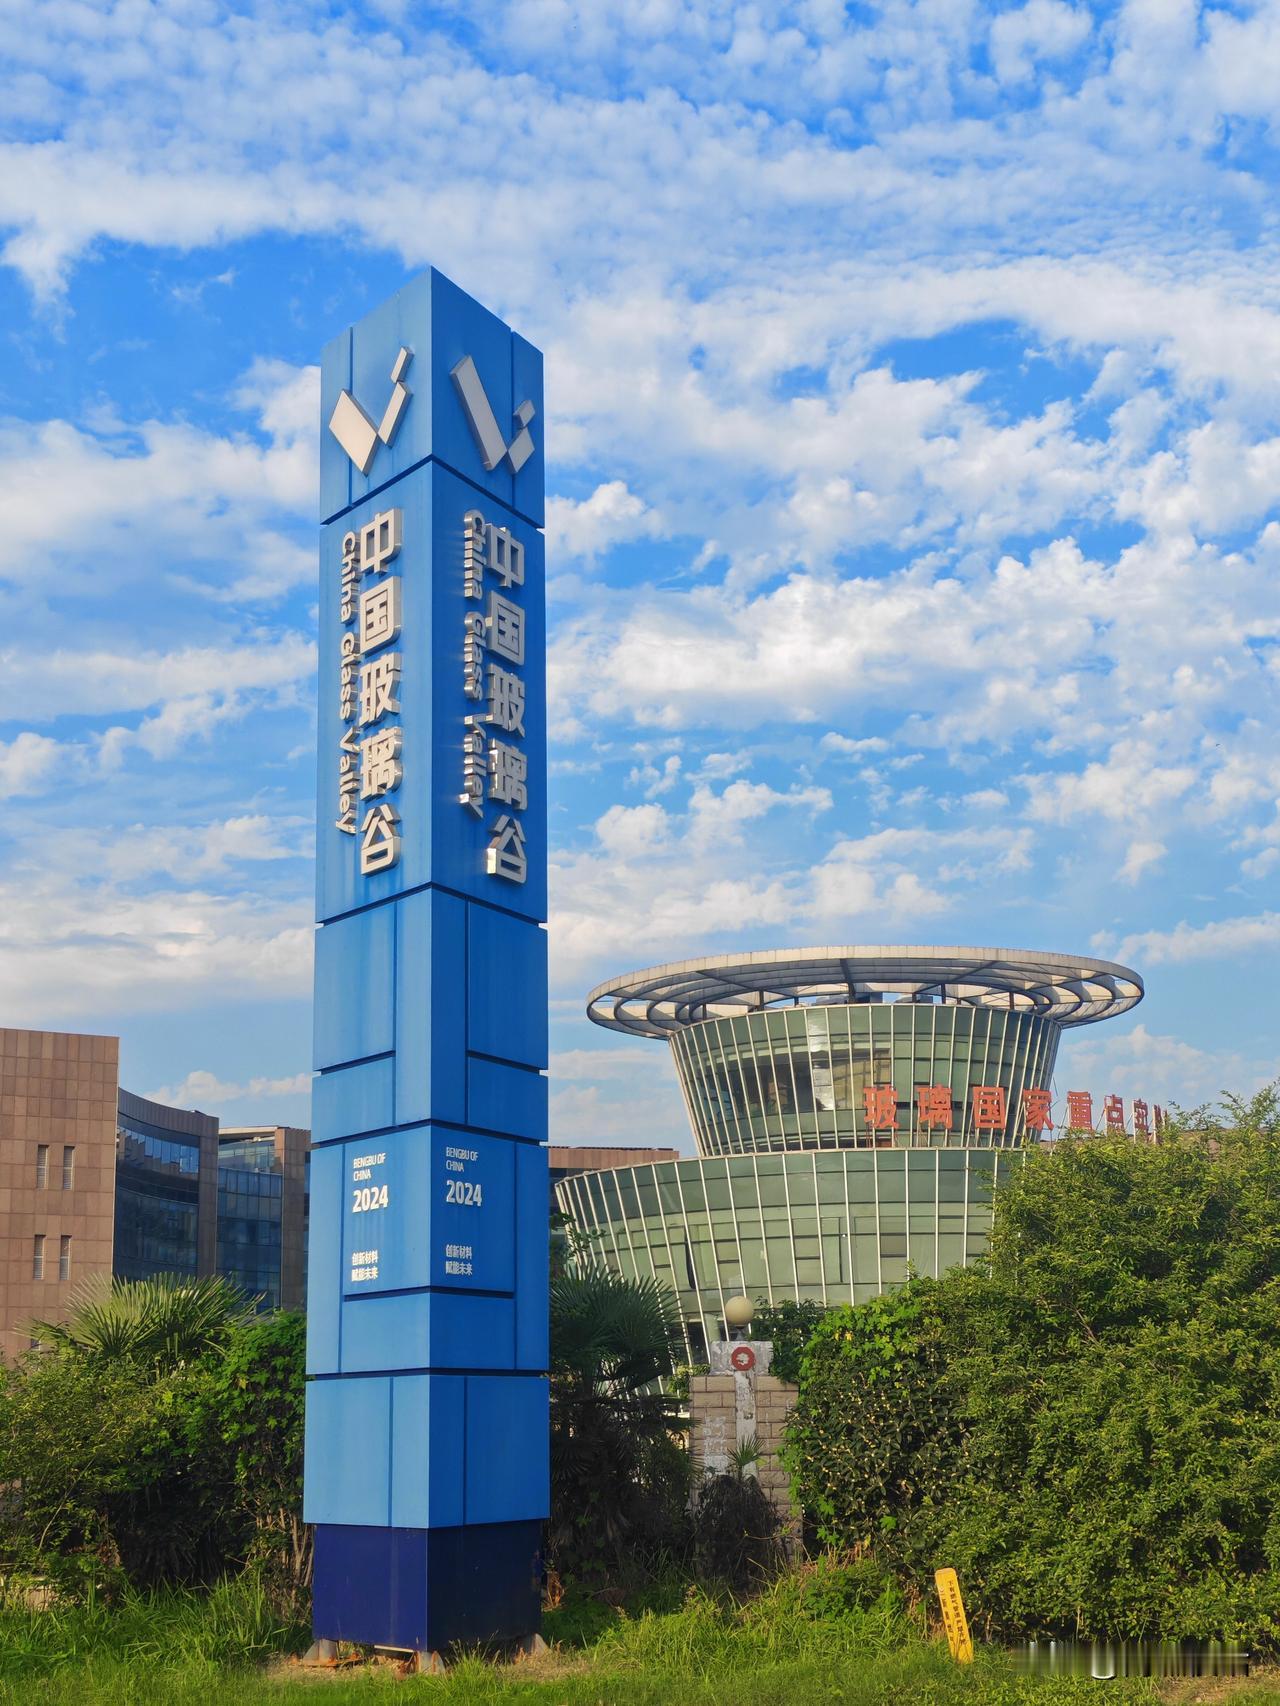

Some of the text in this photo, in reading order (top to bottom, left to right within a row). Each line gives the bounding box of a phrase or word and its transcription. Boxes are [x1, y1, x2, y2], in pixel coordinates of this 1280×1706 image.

[460, 510, 488, 818] China Glass Valley
[336, 532, 360, 834] China Glass Valley
[361, 509, 402, 876] 中国玻璃谷
[487, 524, 527, 883] 中国玻璃谷
[354, 1153, 386, 1168] BENGBU OF
[446, 1148, 479, 1161] BENGBU OF
[354, 1169, 371, 1181] CHINA
[446, 1161, 464, 1172] CHINA
[353, 1186, 388, 1212] 2024
[447, 1181, 482, 1206] 2024
[352, 1251, 378, 1265] 创新材料
[446, 1245, 472, 1259] 创新材料
